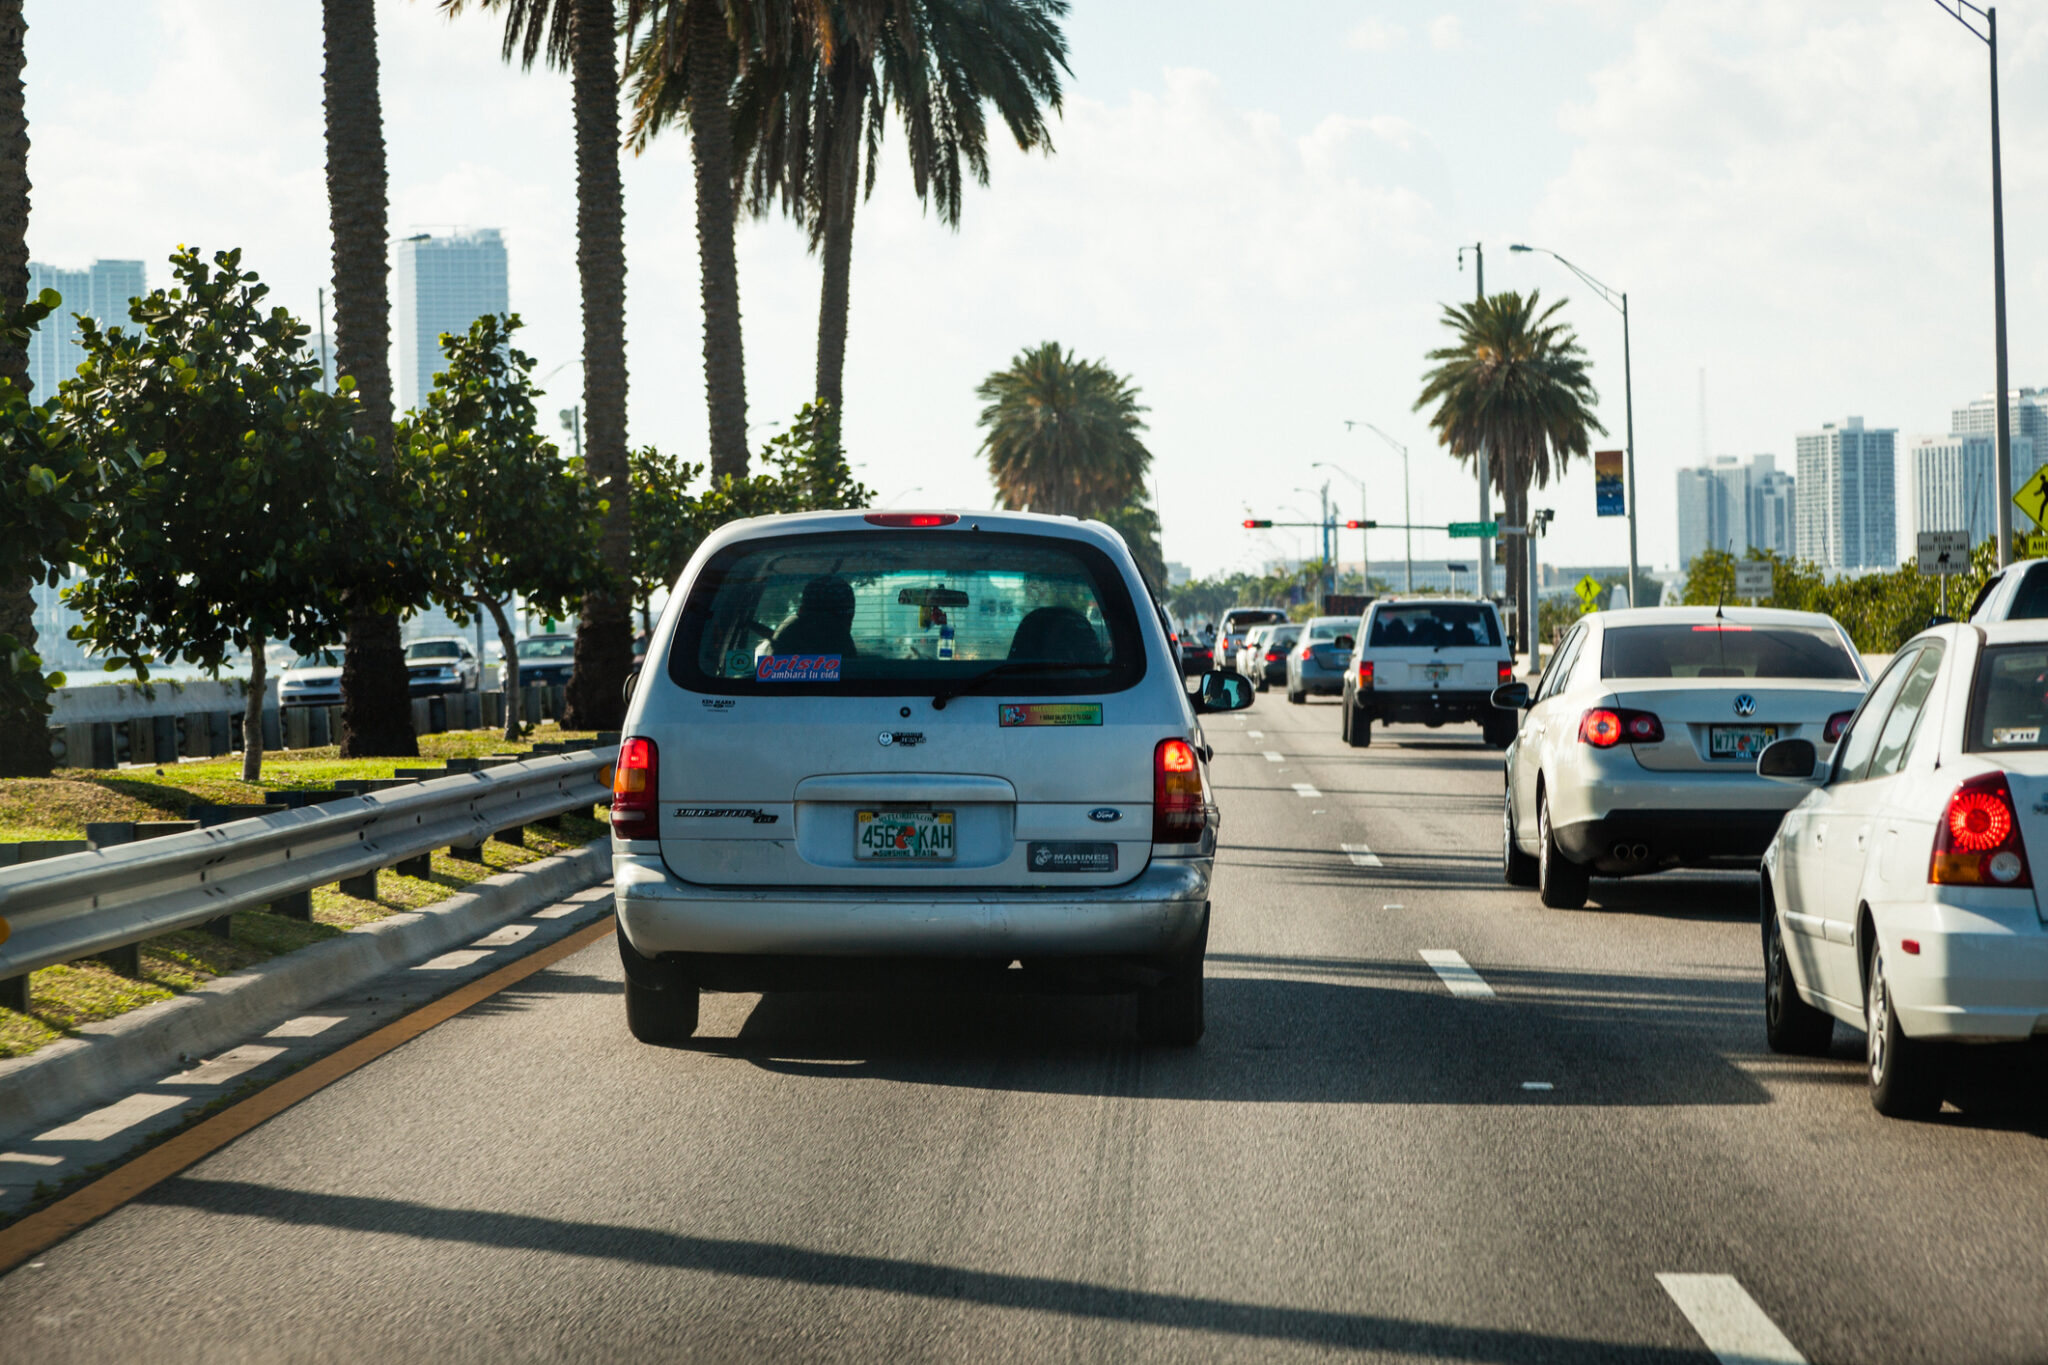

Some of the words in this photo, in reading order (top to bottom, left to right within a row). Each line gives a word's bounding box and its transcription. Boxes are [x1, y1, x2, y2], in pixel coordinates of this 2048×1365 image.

[758, 655, 839, 679] Cristo
[809, 670, 818, 679] tu
[820, 669, 839, 679] vida
[862, 825, 896, 849] 456
[918, 825, 952, 849] KAH
[878, 849, 911, 857] SUNSHINE
[1054, 853, 1109, 861] MARINES
